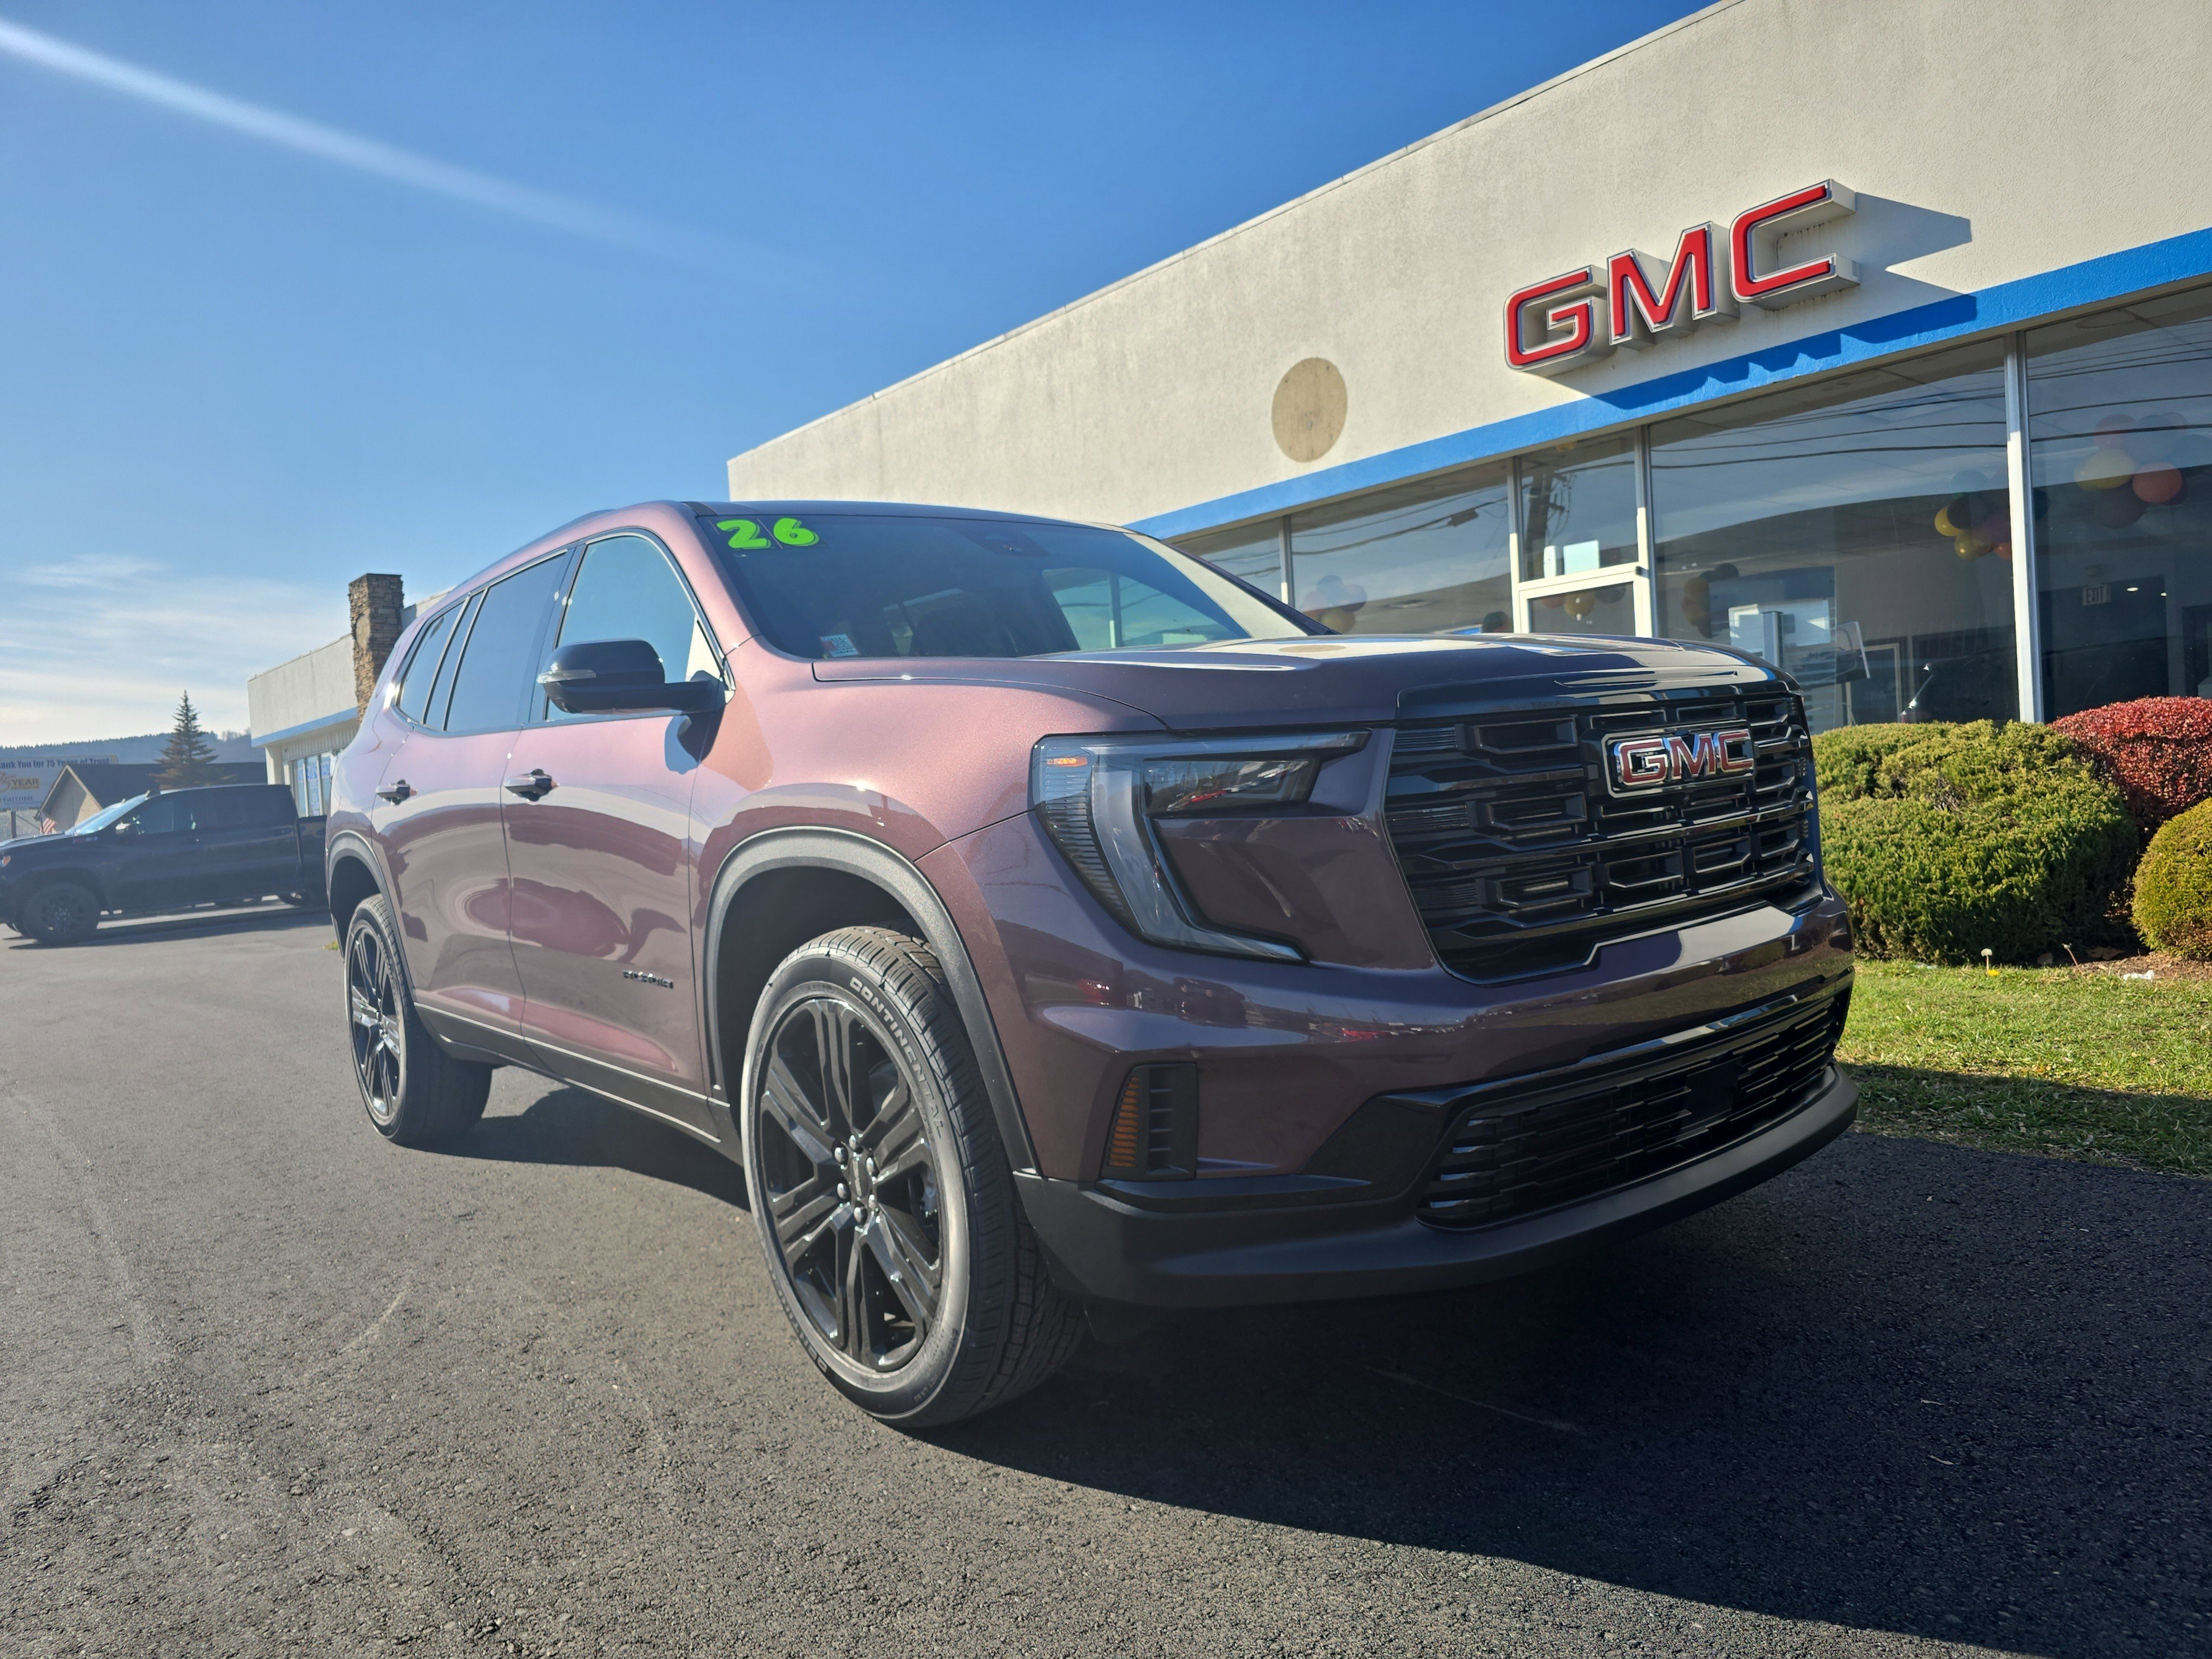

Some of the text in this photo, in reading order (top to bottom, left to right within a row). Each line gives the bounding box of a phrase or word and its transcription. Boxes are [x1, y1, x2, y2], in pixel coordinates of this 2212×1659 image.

[1504, 179, 1839, 372] GMC
[716, 517, 820, 549] 26
[2086, 587, 2104, 603] EXIT
[17, 761, 31, 769] You
[33, 760, 44, 768] for
[47, 760, 55, 768] 75
[1616, 729, 1754, 786] GMC
[850, 976, 943, 1139] CONTINENTAL
